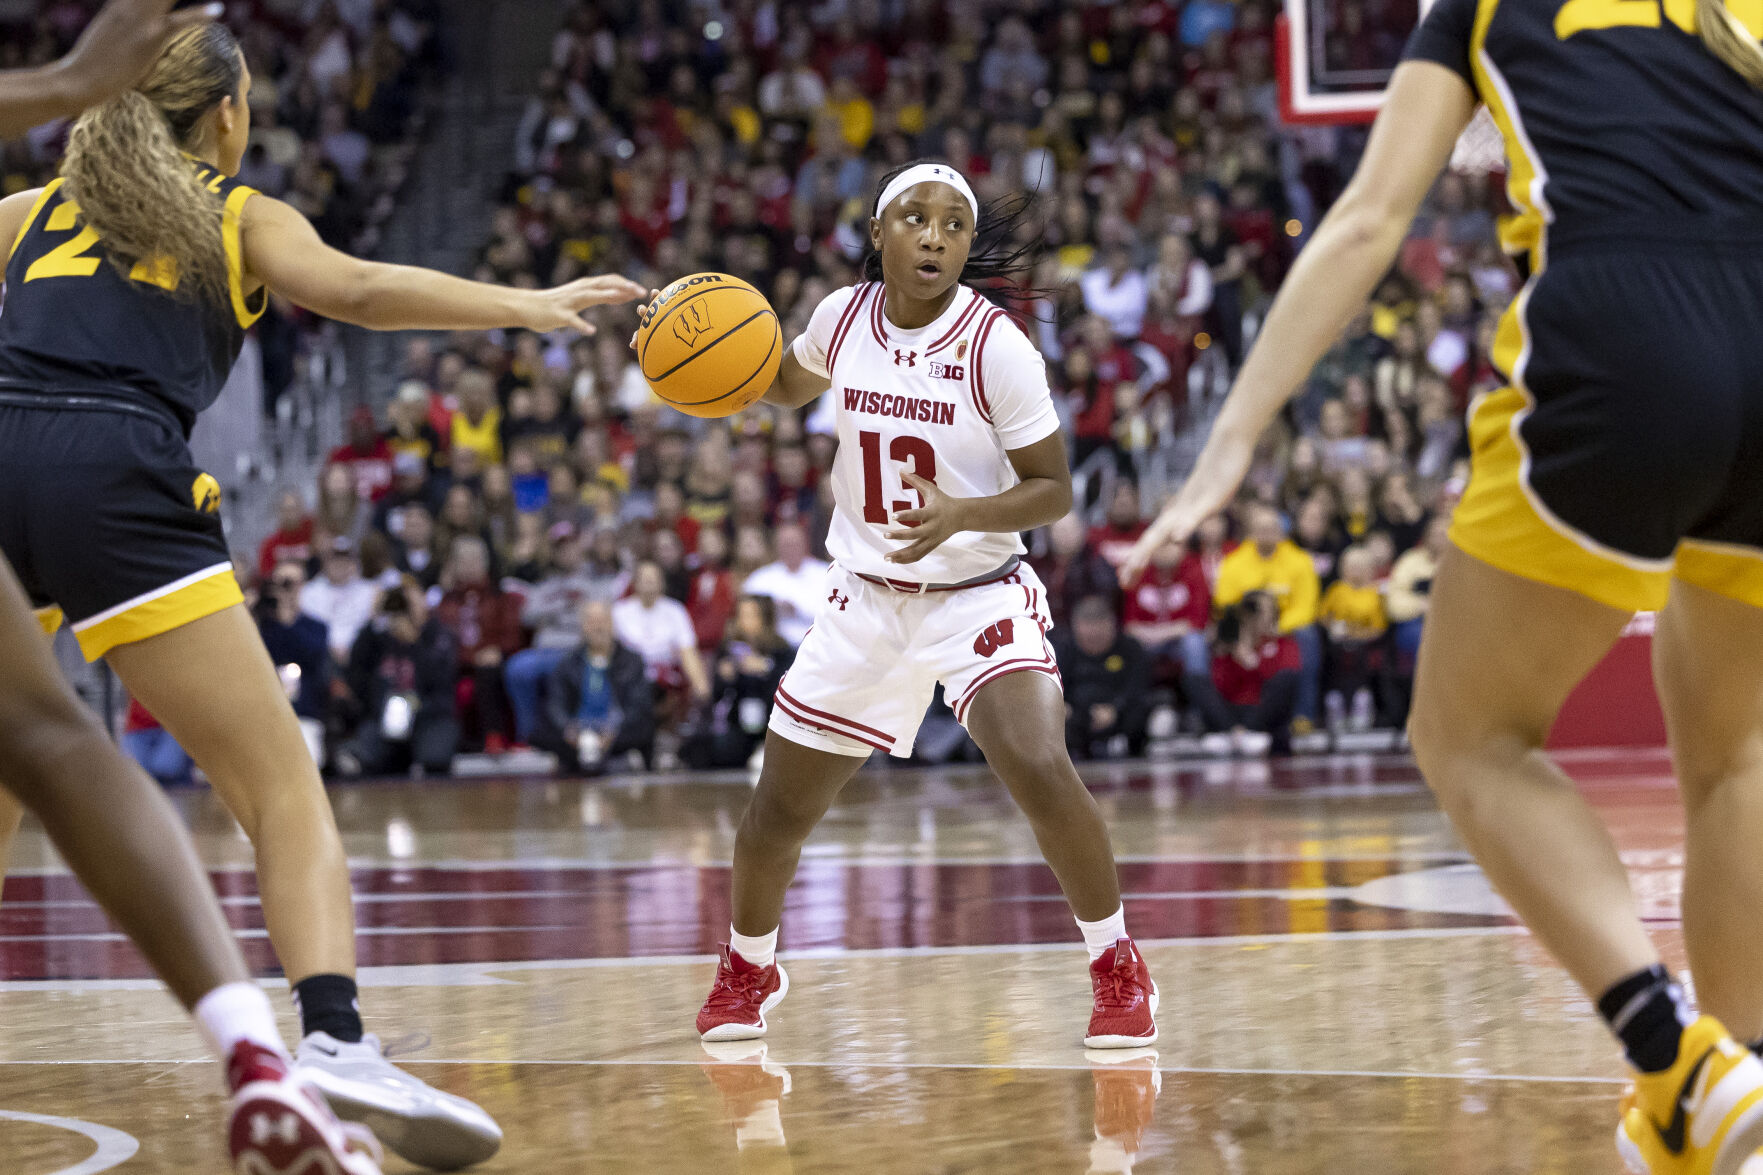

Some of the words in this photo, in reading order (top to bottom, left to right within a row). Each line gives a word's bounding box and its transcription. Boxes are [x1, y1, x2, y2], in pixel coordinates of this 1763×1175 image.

[844, 387, 956, 426] WISCONSIN
[859, 430, 937, 528] 13
[973, 618, 1014, 658] W
